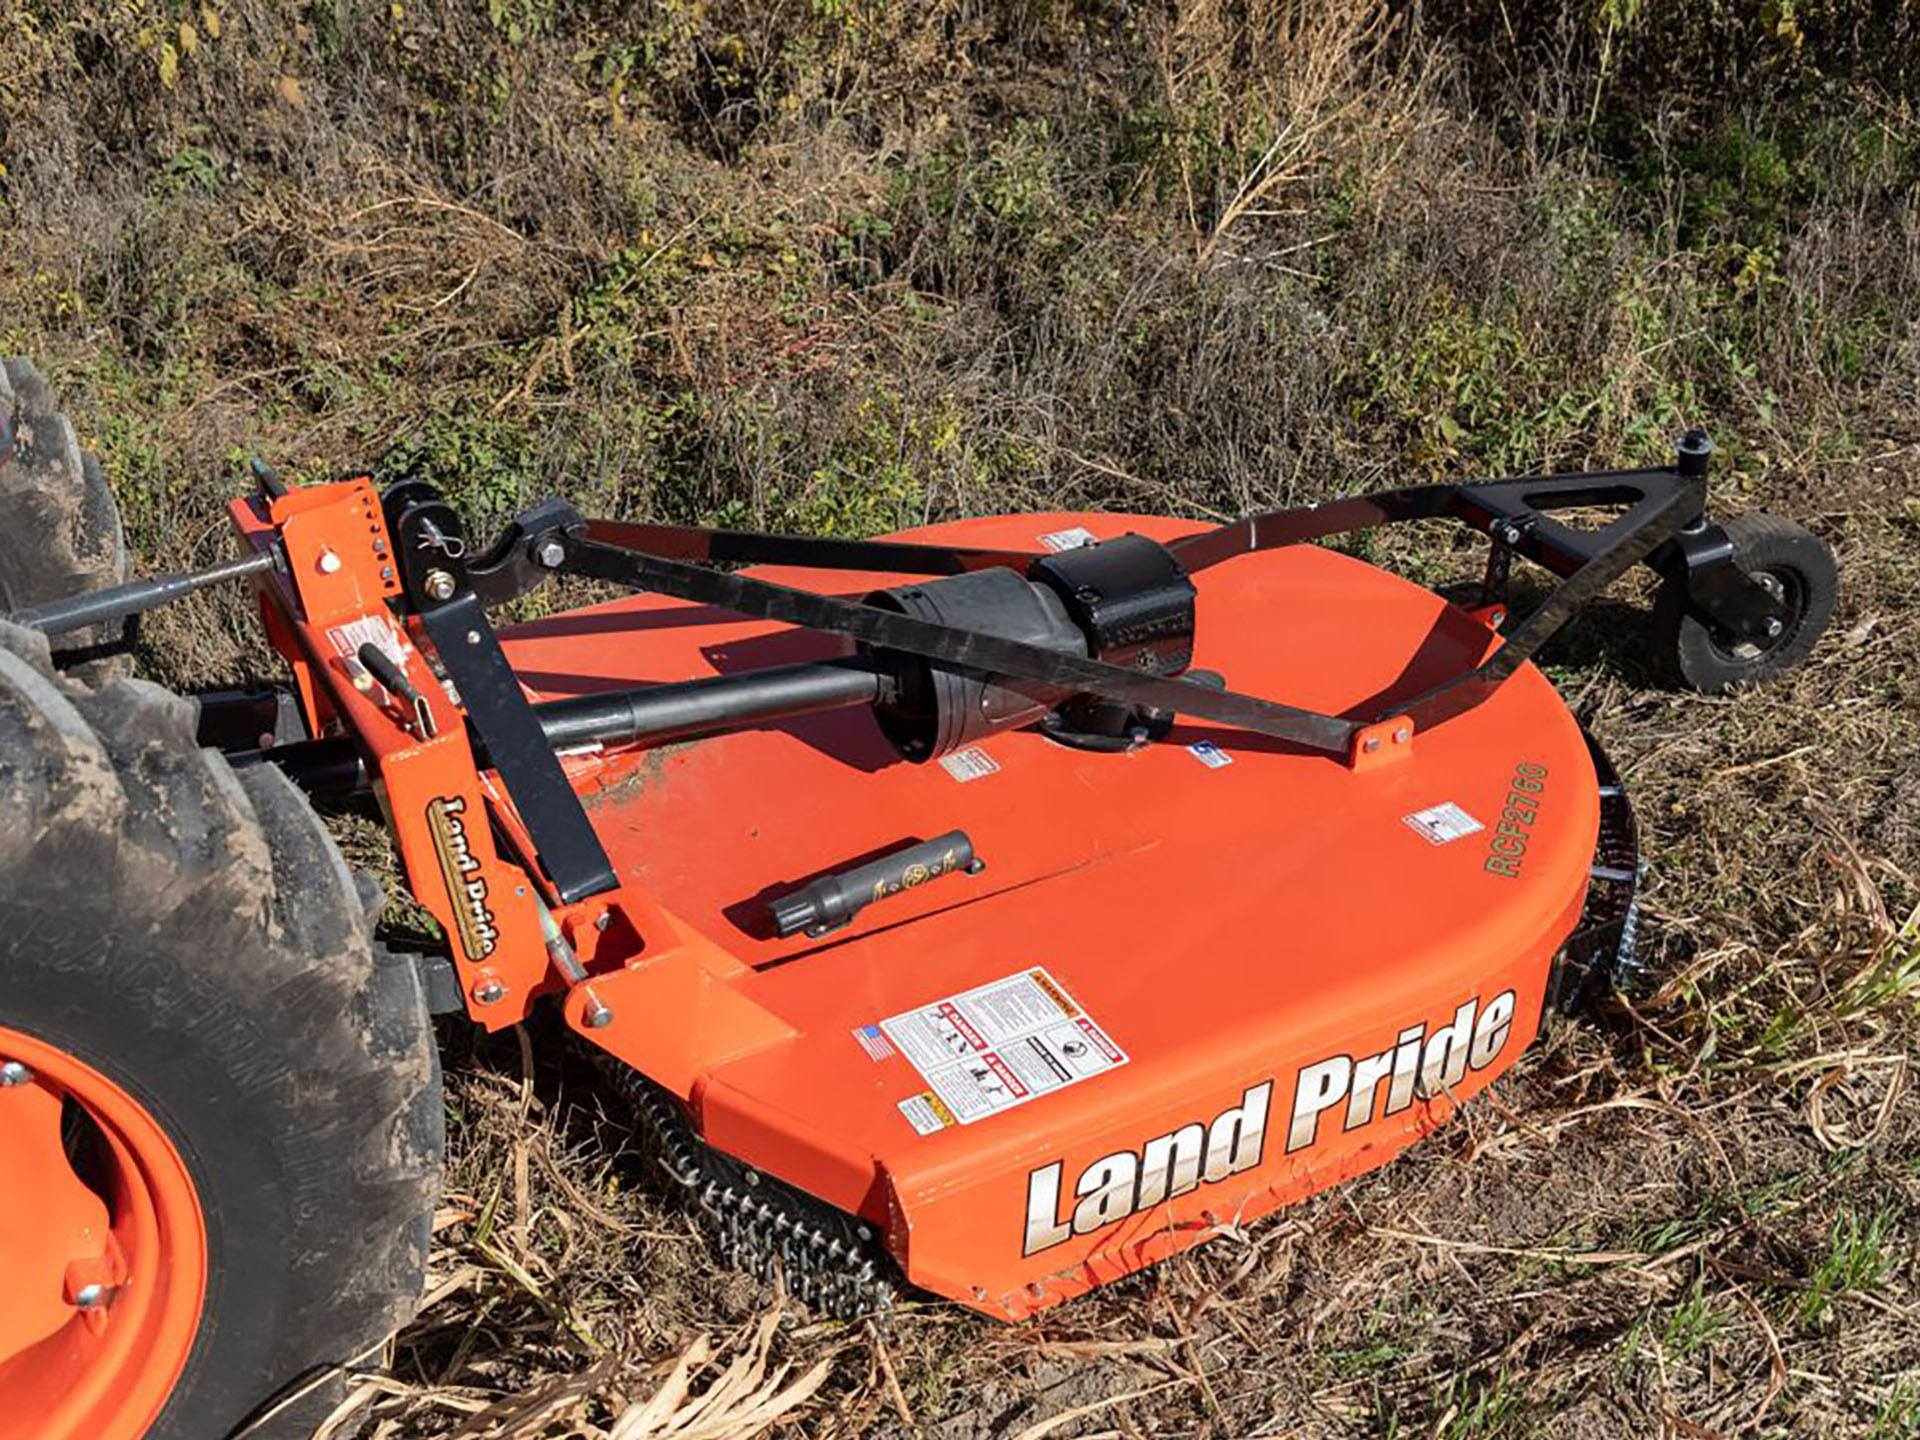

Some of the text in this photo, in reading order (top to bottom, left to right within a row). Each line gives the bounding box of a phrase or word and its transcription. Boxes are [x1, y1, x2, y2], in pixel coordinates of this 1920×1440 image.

[434, 796, 500, 956] Land Pride
[1484, 761, 1547, 877] RCF2760
[1022, 988, 1516, 1258] Land Pride
